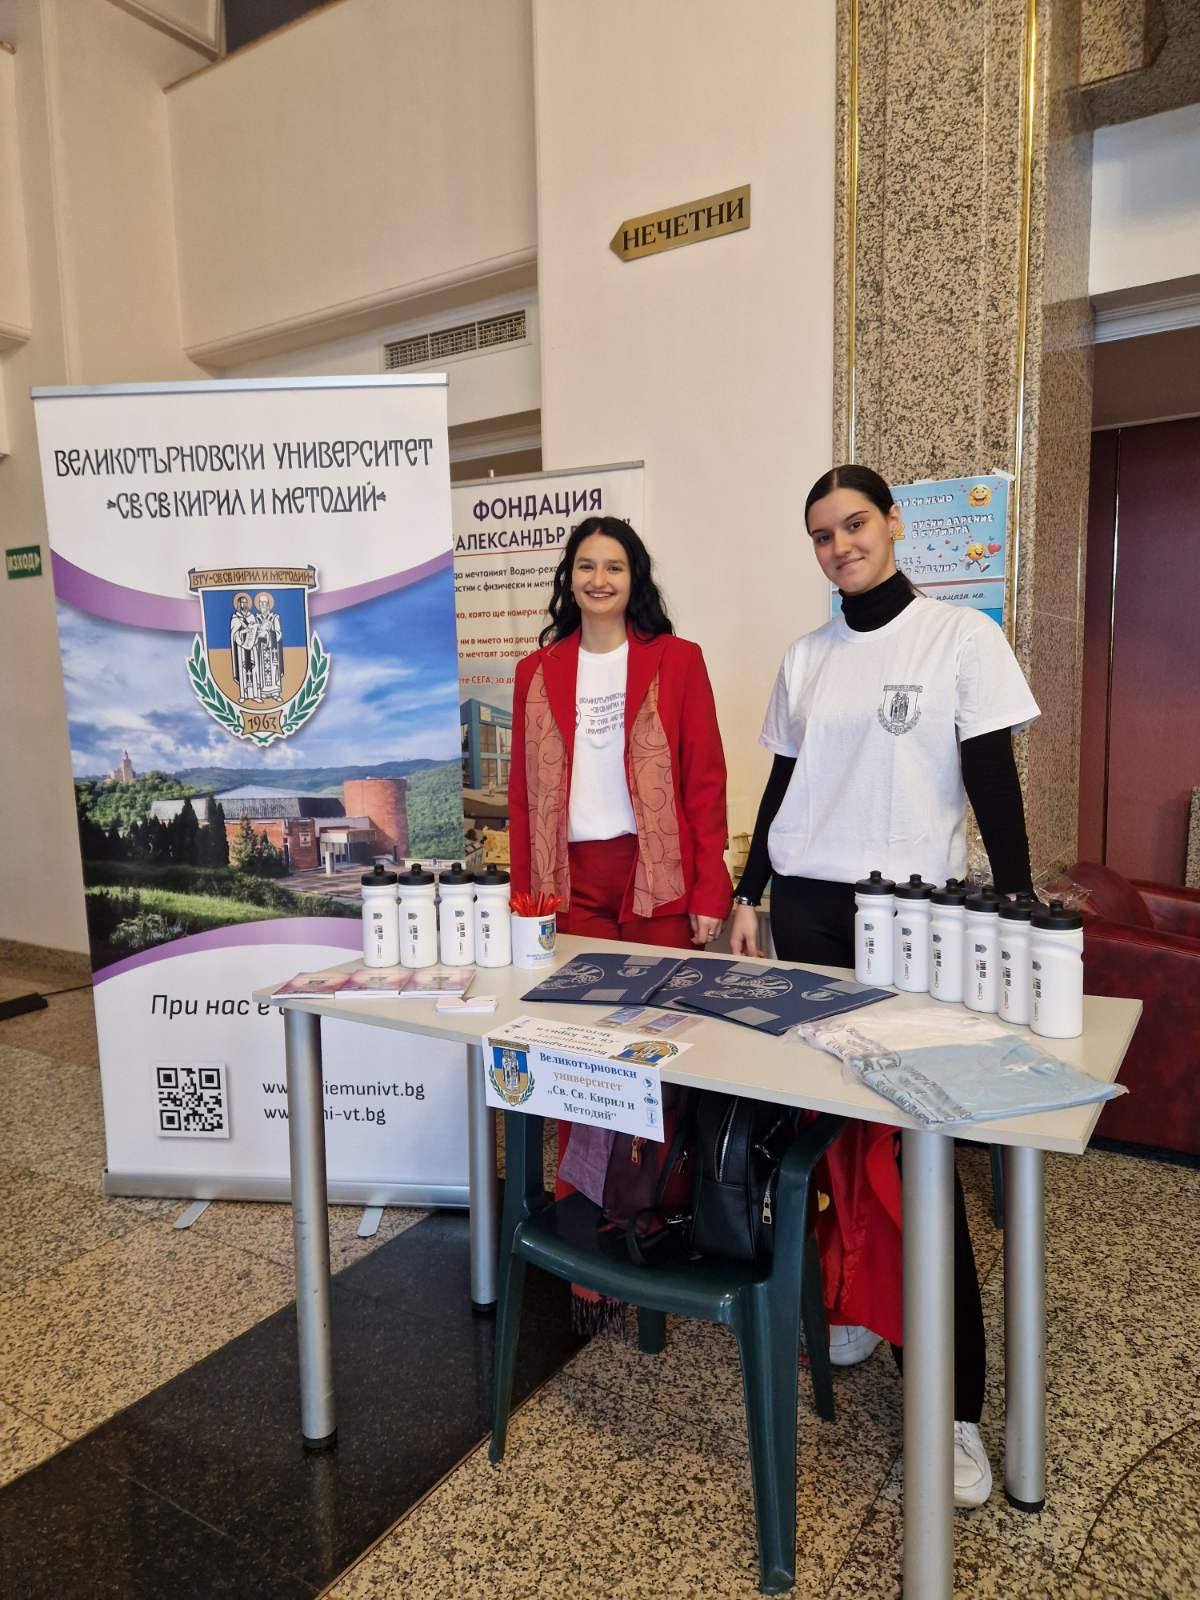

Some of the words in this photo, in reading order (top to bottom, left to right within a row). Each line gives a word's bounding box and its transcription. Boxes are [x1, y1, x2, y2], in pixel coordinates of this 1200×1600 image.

[622, 197, 744, 251] НЕЧЕТНИ
[54, 442, 265, 477] ВЕЛИКОТЪРНОВСКИ
[274, 438, 433, 470] УНИВЕРСИТЕТ
[250, 488, 265, 516] И
[473, 488, 602, 521] ФОНДАЦИЯ
[483, 582, 526, 592] физически
[492, 609, 505, 618] ще
[515, 636, 539, 644] децат
[248, 714, 277, 731] 1963
[151, 994, 198, 1020] При
[205, 1000, 250, 1016] нас
[540, 1052, 637, 1079] Великотърновски
[553, 1071, 623, 1092] университет
[571, 1088, 587, 1100] Св.
[590, 1092, 625, 1108] Кирил
[627, 1102, 635, 1110] и
